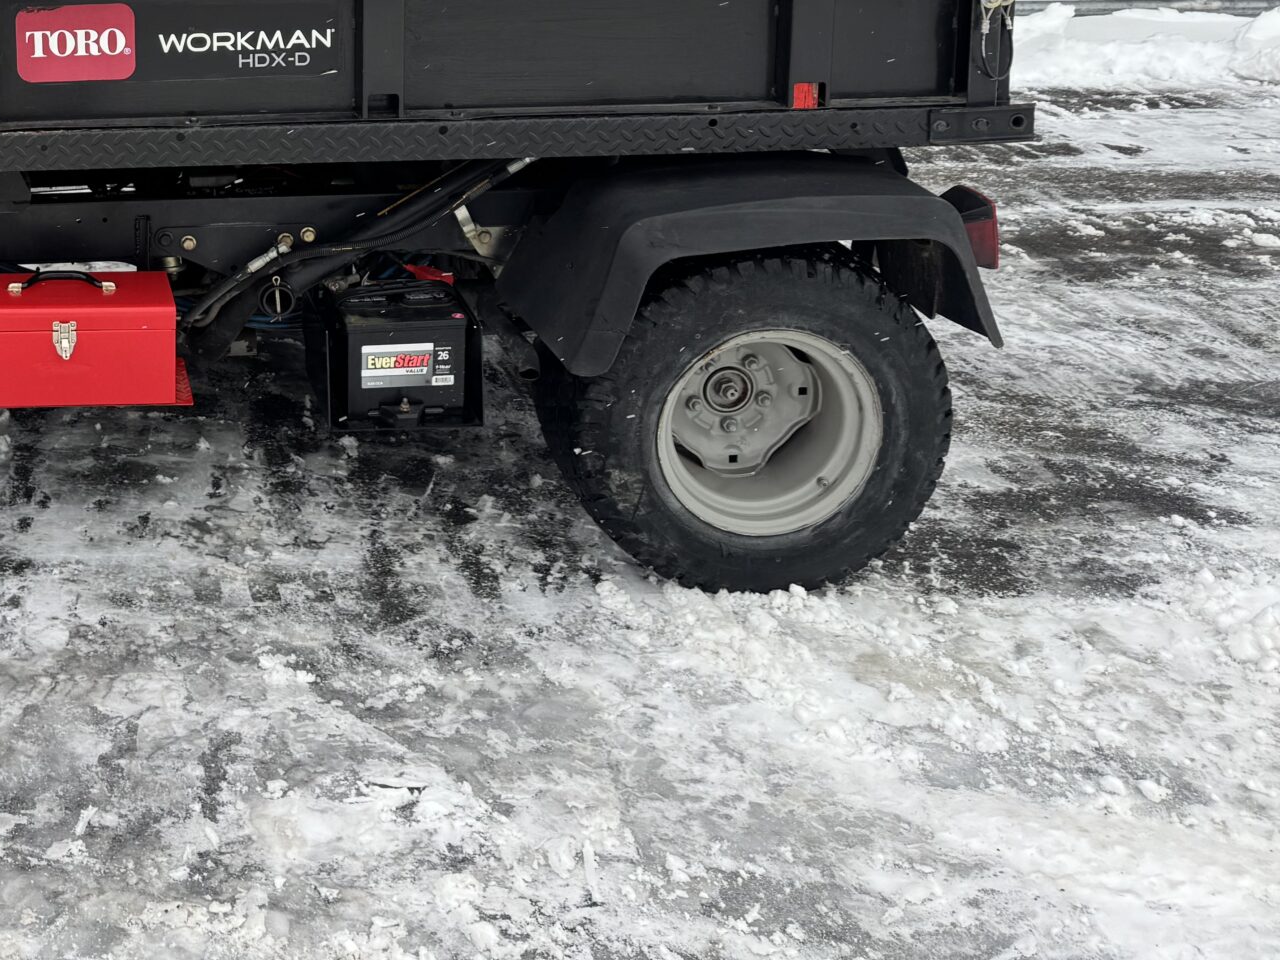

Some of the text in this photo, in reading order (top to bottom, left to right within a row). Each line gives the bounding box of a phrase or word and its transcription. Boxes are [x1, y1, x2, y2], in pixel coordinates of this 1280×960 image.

[25, 27, 126, 58] TORO
[158, 29, 333, 53] WORKMAN
[238, 52, 311, 68] HDX-D
[367, 353, 430, 369] EverStart
[437, 351, 449, 360] 26
